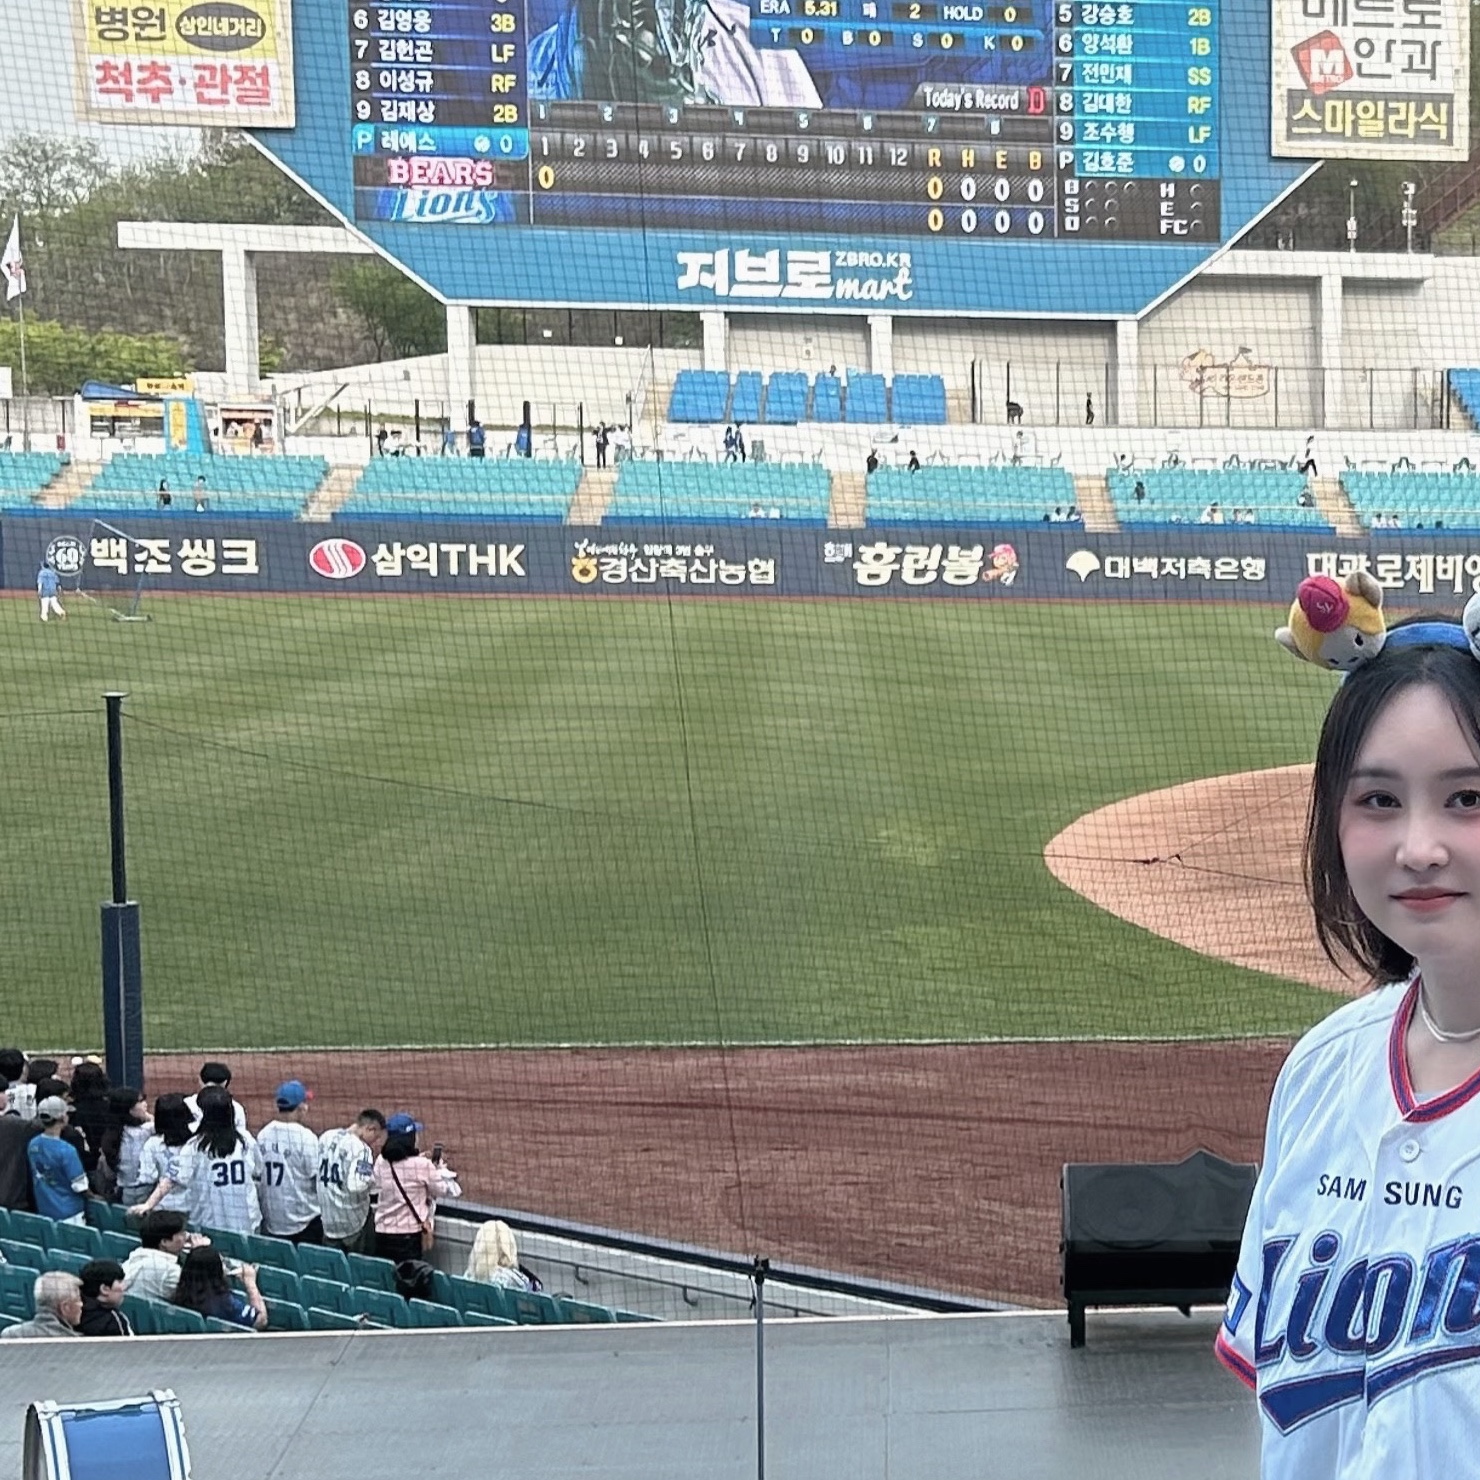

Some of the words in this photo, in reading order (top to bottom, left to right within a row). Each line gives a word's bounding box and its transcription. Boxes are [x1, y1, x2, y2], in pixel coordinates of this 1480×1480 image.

[353, 9, 368, 29] 6
[490, 13, 515, 32] 3B
[760, 1, 790, 14] ERA
[909, 5, 921, 19] 2
[943, 6, 983, 21] HOLD
[1004, 7, 1017, 22] 0
[1059, 4, 1072, 22] 5
[1081, 3, 1134, 25] 강승호
[1188, 8, 1212, 26] 2B
[95, 6, 167, 41] 병원
[801, 28, 814, 43] 0
[869, 31, 881, 45] 0
[940, 33, 953, 48] 0
[984, 36, 996, 50] K
[1012, 35, 1023, 50] 0
[1058, 34, 1072, 52] 6
[1189, 37, 1211, 56] 1B
[354, 40, 369, 59] 7
[379, 39, 433, 62] 김헌곤
[491, 44, 515, 63] LF
[1354, 37, 1442, 81] 안과
[355, 70, 370, 90] 8
[379, 70, 434, 93] 이성규
[491, 73, 517, 93] RF
[1059, 63, 1072, 82] 7
[1187, 67, 1212, 86] SS
[924, 87, 973, 110] Today's
[976, 90, 1019, 110] Record
[1059, 92, 1073, 111] 8
[1082, 92, 1132, 114] 김대한
[1188, 96, 1212, 114] RF
[356, 100, 371, 120] 9
[493, 104, 518, 123] 2B
[603, 106, 613, 121] 2
[1291, 99, 1448, 140] 스마일라식
[357, 130, 373, 149] P
[1060, 122, 1073, 141] 9
[1083, 122, 1135, 144] 조수행
[1188, 126, 1212, 144] LF
[541, 135, 549, 156] 1
[573, 138, 585, 157] 2
[606, 138, 618, 158] 3
[638, 139, 650, 160] 4
[670, 141, 682, 160] 5
[734, 143, 746, 161] 7
[766, 143, 777, 162] 8
[797, 144, 809, 163] 9
[826, 145, 845, 165] 10
[859, 146, 873, 165] 11
[889, 147, 908, 166] 12
[927, 148, 941, 167] R
[962, 149, 974, 168] H
[996, 150, 1007, 169] E
[1029, 151, 1042, 170] B
[1059, 151, 1074, 169] P
[1083, 151, 1135, 173] 김호준
[388, 157, 494, 187] BEARS
[538, 165, 555, 189] 0
[927, 176, 943, 199] 0
[960, 177, 976, 201] 0
[994, 178, 1010, 201] 0
[1027, 179, 1044, 202] 0
[1160, 182, 1175, 198] H
[390, 187, 498, 223] Lions
[927, 208, 944, 231] 0
[961, 209, 977, 232] 0
[994, 210, 1010, 233] 0
[1028, 211, 1044, 234] 0
[1160, 201, 1174, 216] E
[1160, 219, 1188, 235] FC
[676, 248, 835, 299] 지브로
[835, 266, 913, 300] mart
[89, 538, 260, 576] 백조씽크
[371, 542, 526, 577] 삼익THK
[853, 542, 985, 586] 홈런볼
[1104, 556, 1266, 581] 대백저축은행
[600, 557, 776, 585] 경산축산농협
[211, 1160, 245, 1187] 30
[264, 1161, 284, 1187] 17
